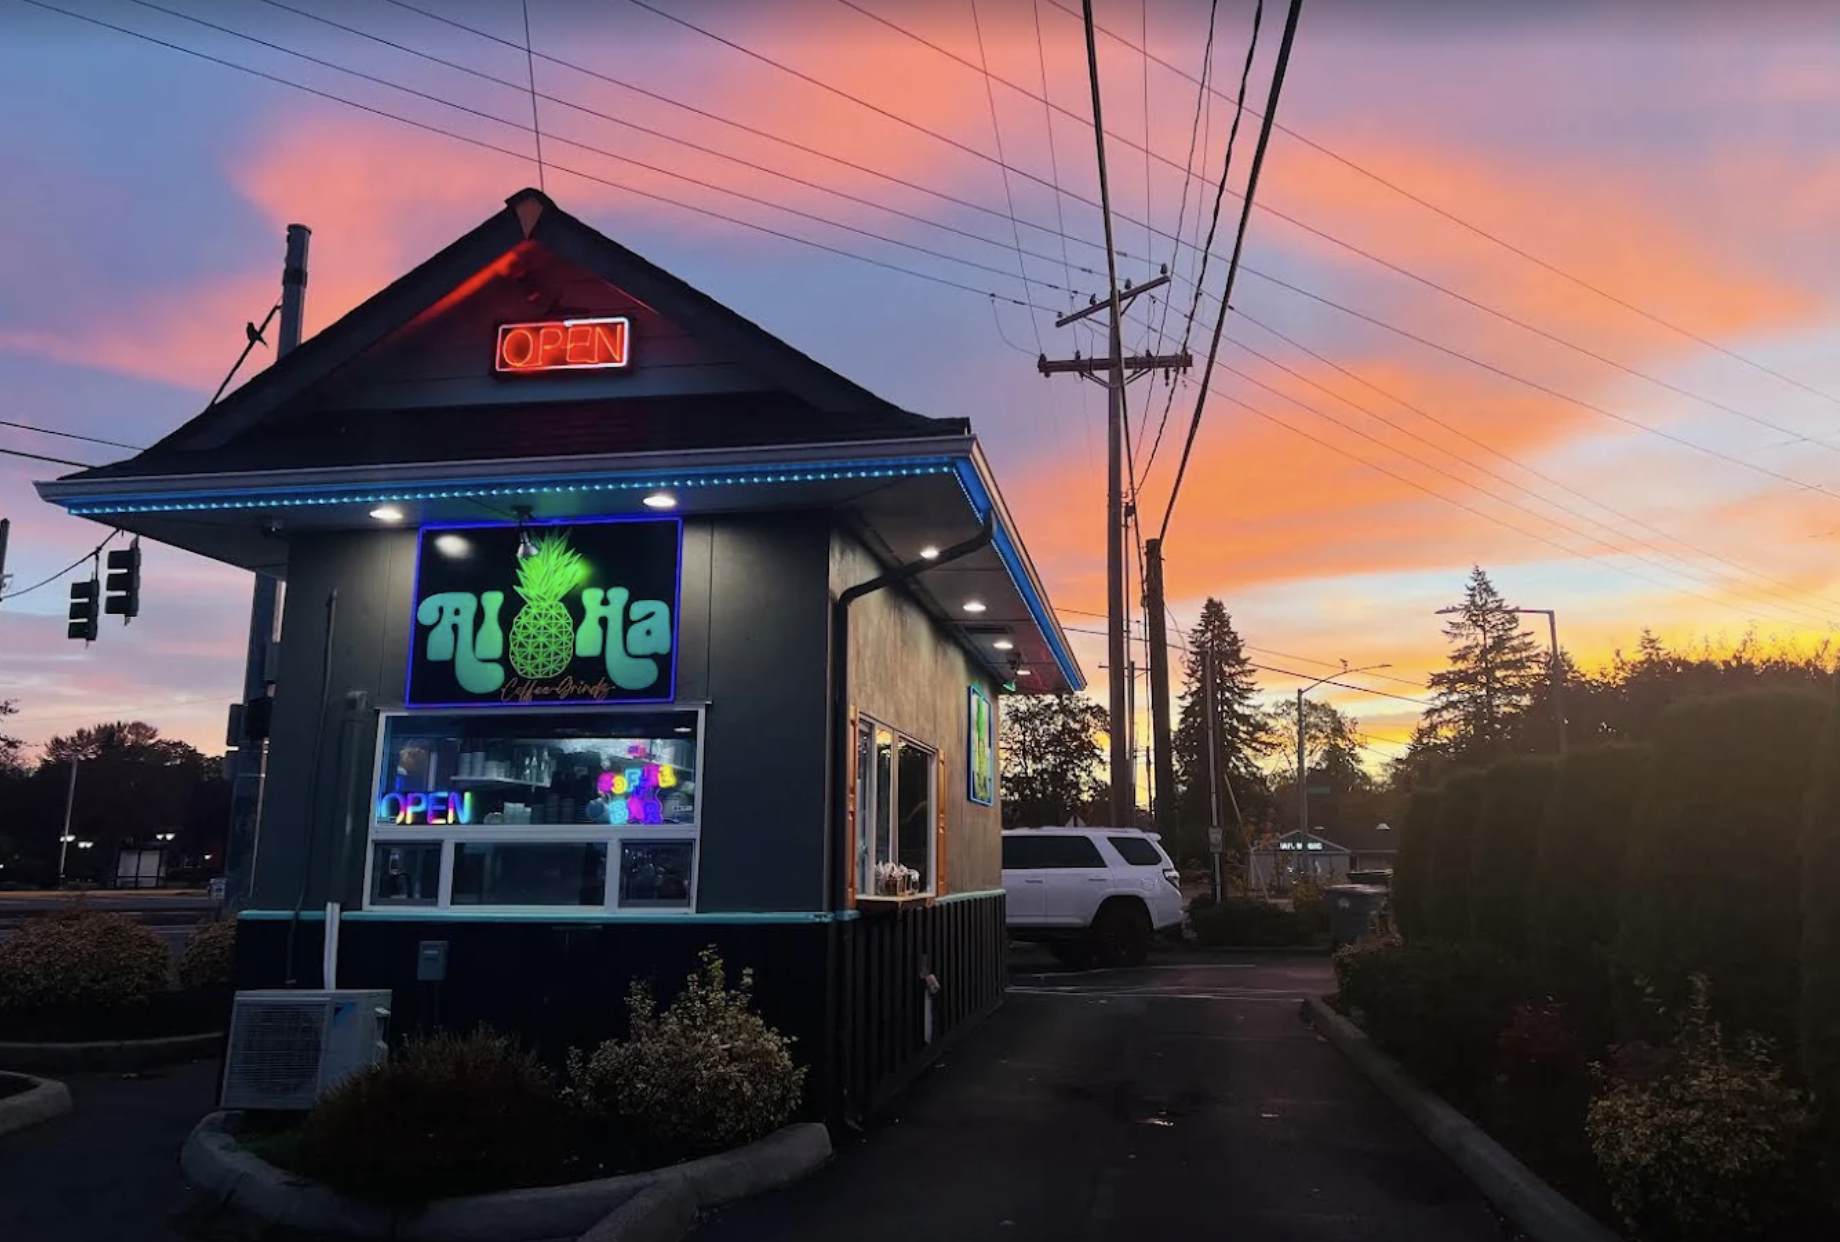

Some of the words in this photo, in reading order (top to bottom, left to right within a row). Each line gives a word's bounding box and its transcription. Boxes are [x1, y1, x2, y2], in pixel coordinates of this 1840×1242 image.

[502, 324, 623, 367] OPEN
[500, 677, 552, 702] Coffee
[380, 792, 472, 825] OPEN
[608, 797, 662, 825] BAR
